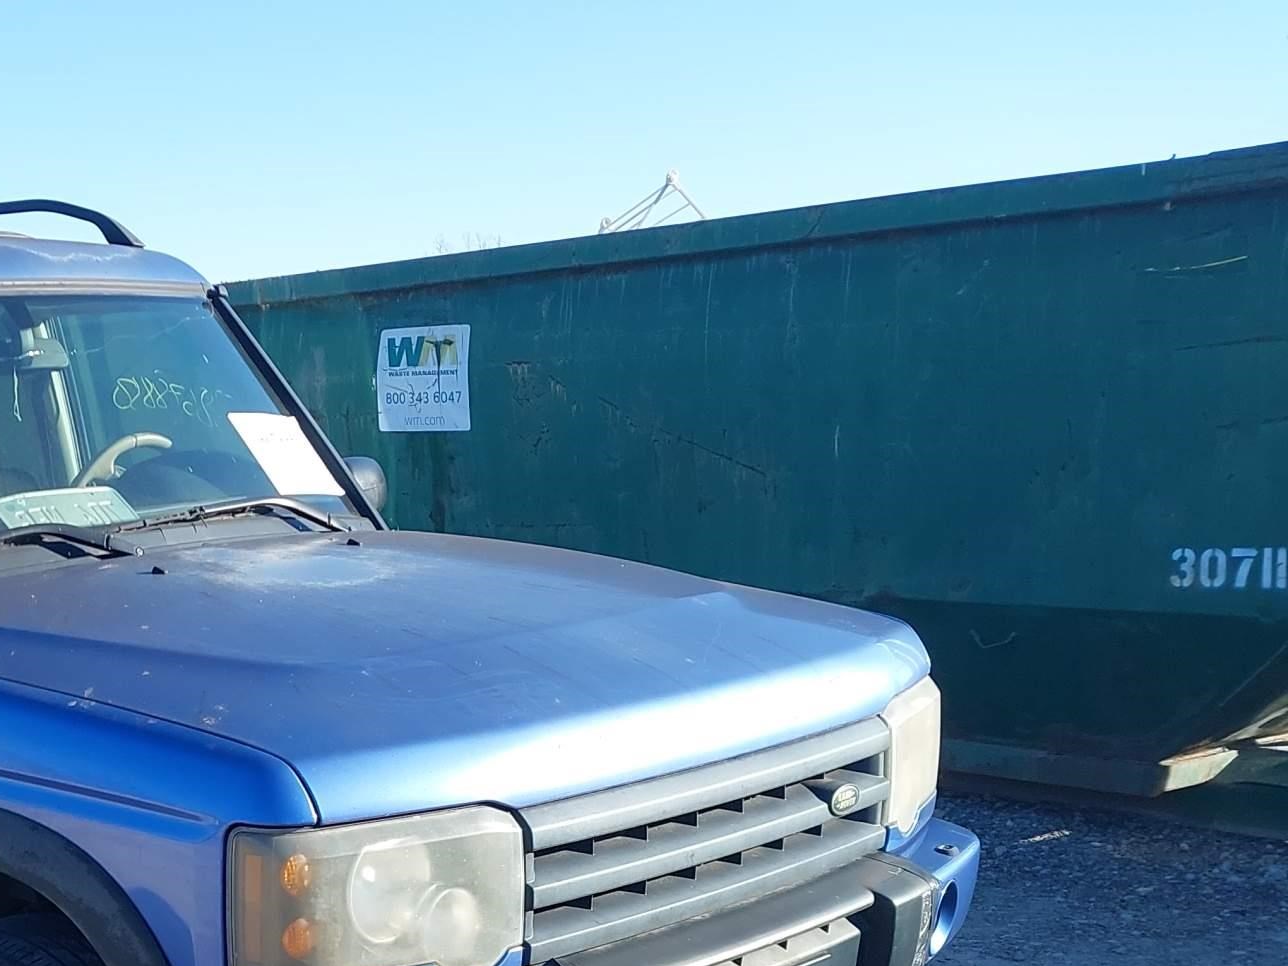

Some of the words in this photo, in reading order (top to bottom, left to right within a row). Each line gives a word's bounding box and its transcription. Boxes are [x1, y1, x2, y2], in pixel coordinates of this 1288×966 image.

[387, 335, 458, 367] WM
[411, 369, 458, 377] MANAGMENT
[386, 392, 406, 404] 800
[408, 391, 430, 404] 343
[433, 391, 462, 404] 6047
[404, 415, 446, 426] wm.com
